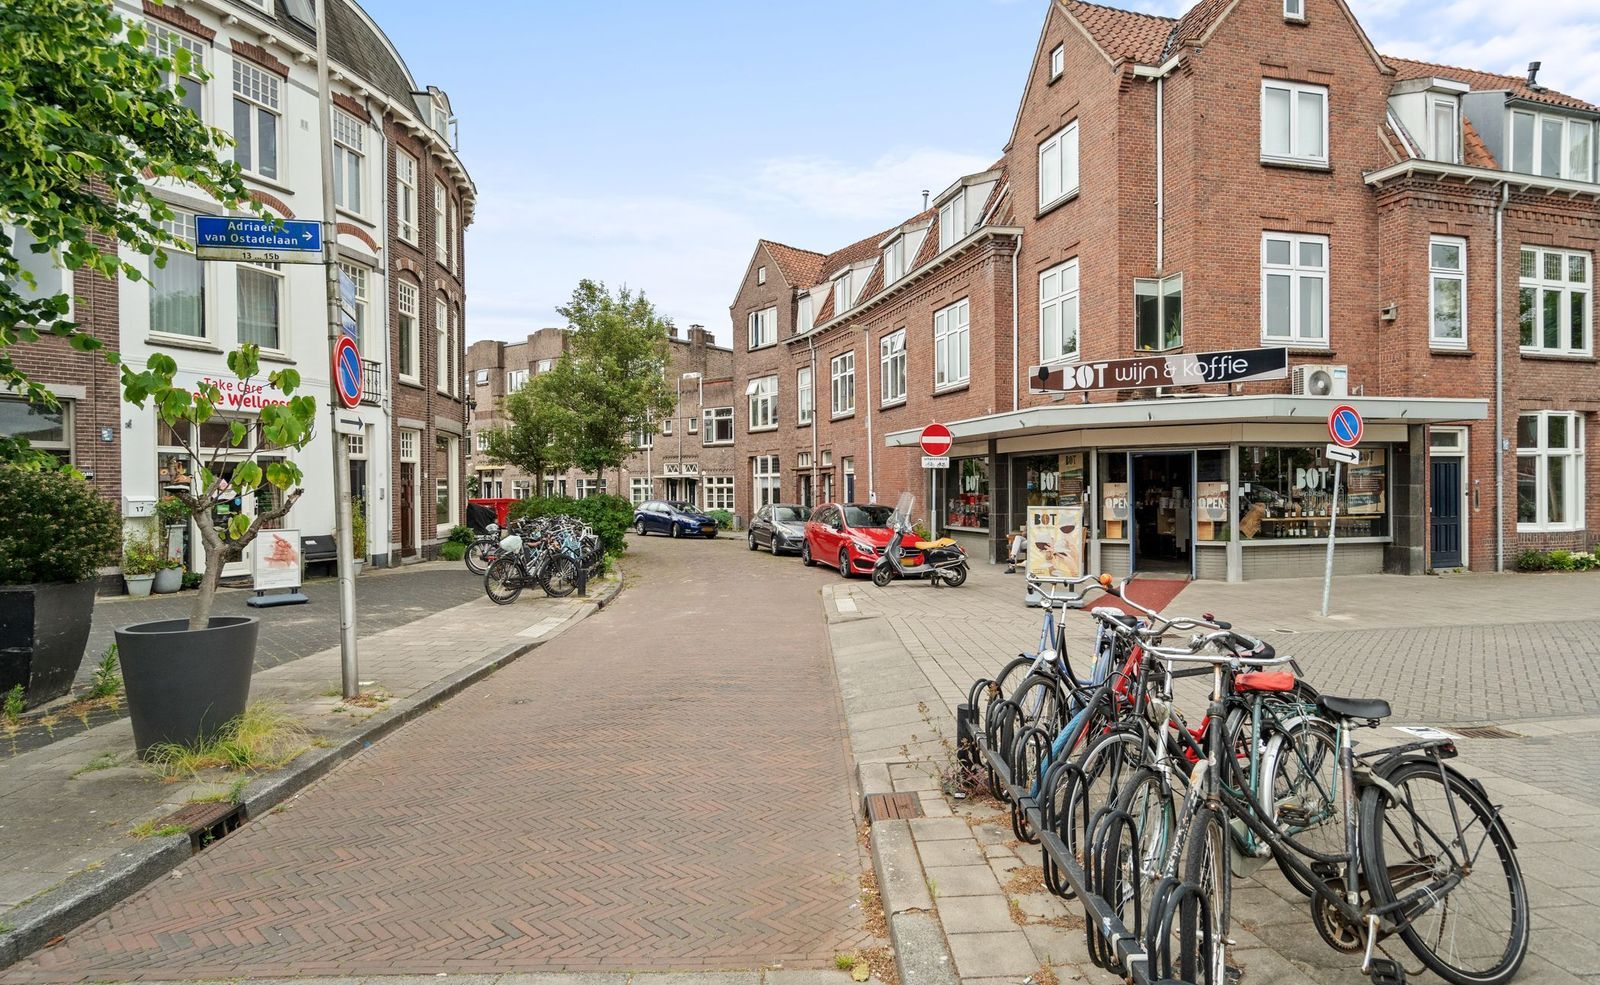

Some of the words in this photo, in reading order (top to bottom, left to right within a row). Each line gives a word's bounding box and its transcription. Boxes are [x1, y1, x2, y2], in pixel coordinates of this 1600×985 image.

[204, 233, 226, 242] van
[230, 233, 298, 245] Ostadelaan
[242, 252, 252, 260] 13
[264, 252, 280, 260] 15b
[1062, 363, 1109, 391] BOT
[1115, 362, 1158, 385] wijn
[1163, 363, 1177, 379] &
[1183, 355, 1249, 380] koffie
[203, 377, 234, 391] Take
[237, 381, 263, 394] Care
[1065, 455, 1077, 466] BOT
[965, 475, 980, 491] BOT
[1040, 472, 1060, 491] BOT
[1296, 467, 1330, 490] BOT
[1104, 497, 1128, 509] OPEN
[1198, 497, 1225, 510] OPEN
[1034, 513, 1057, 526] BOT
